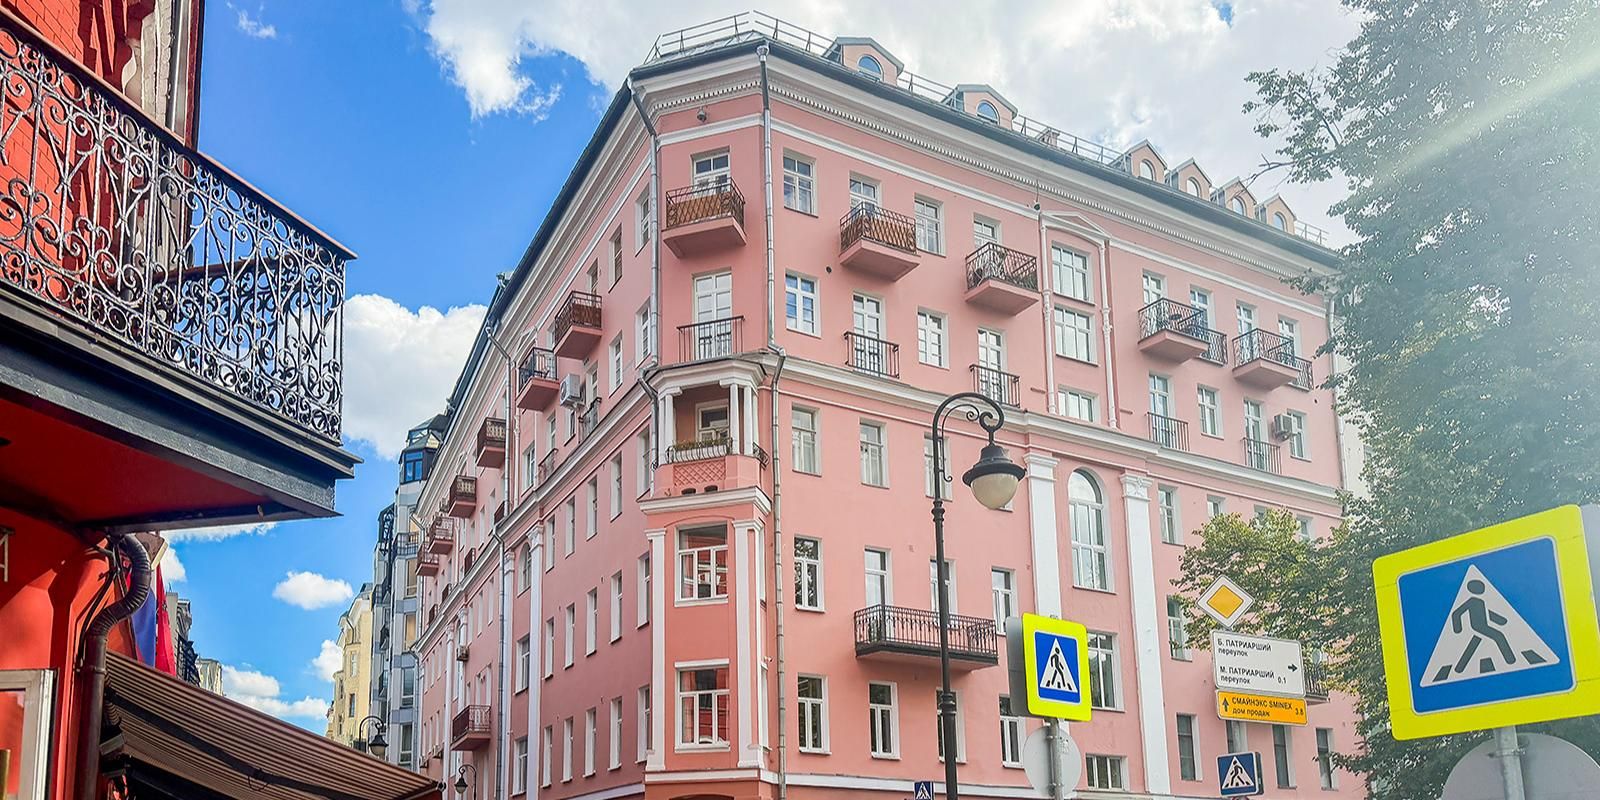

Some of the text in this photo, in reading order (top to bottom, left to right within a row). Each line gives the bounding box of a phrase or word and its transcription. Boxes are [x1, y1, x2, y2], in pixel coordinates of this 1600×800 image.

[1217, 638, 1272, 652] Б. ПАТРИАРШИЙ
[1218, 647, 1248, 657] переулок
[1220, 666, 1275, 679] М. ПАТРИАРШИЙ
[1221, 675, 1250, 684] переулок
[1277, 676, 1287, 684] 0.1
[1232, 697, 1293, 710] СМАЙНЭКС SMINEX
[1246, 709, 1270, 717] продаж
